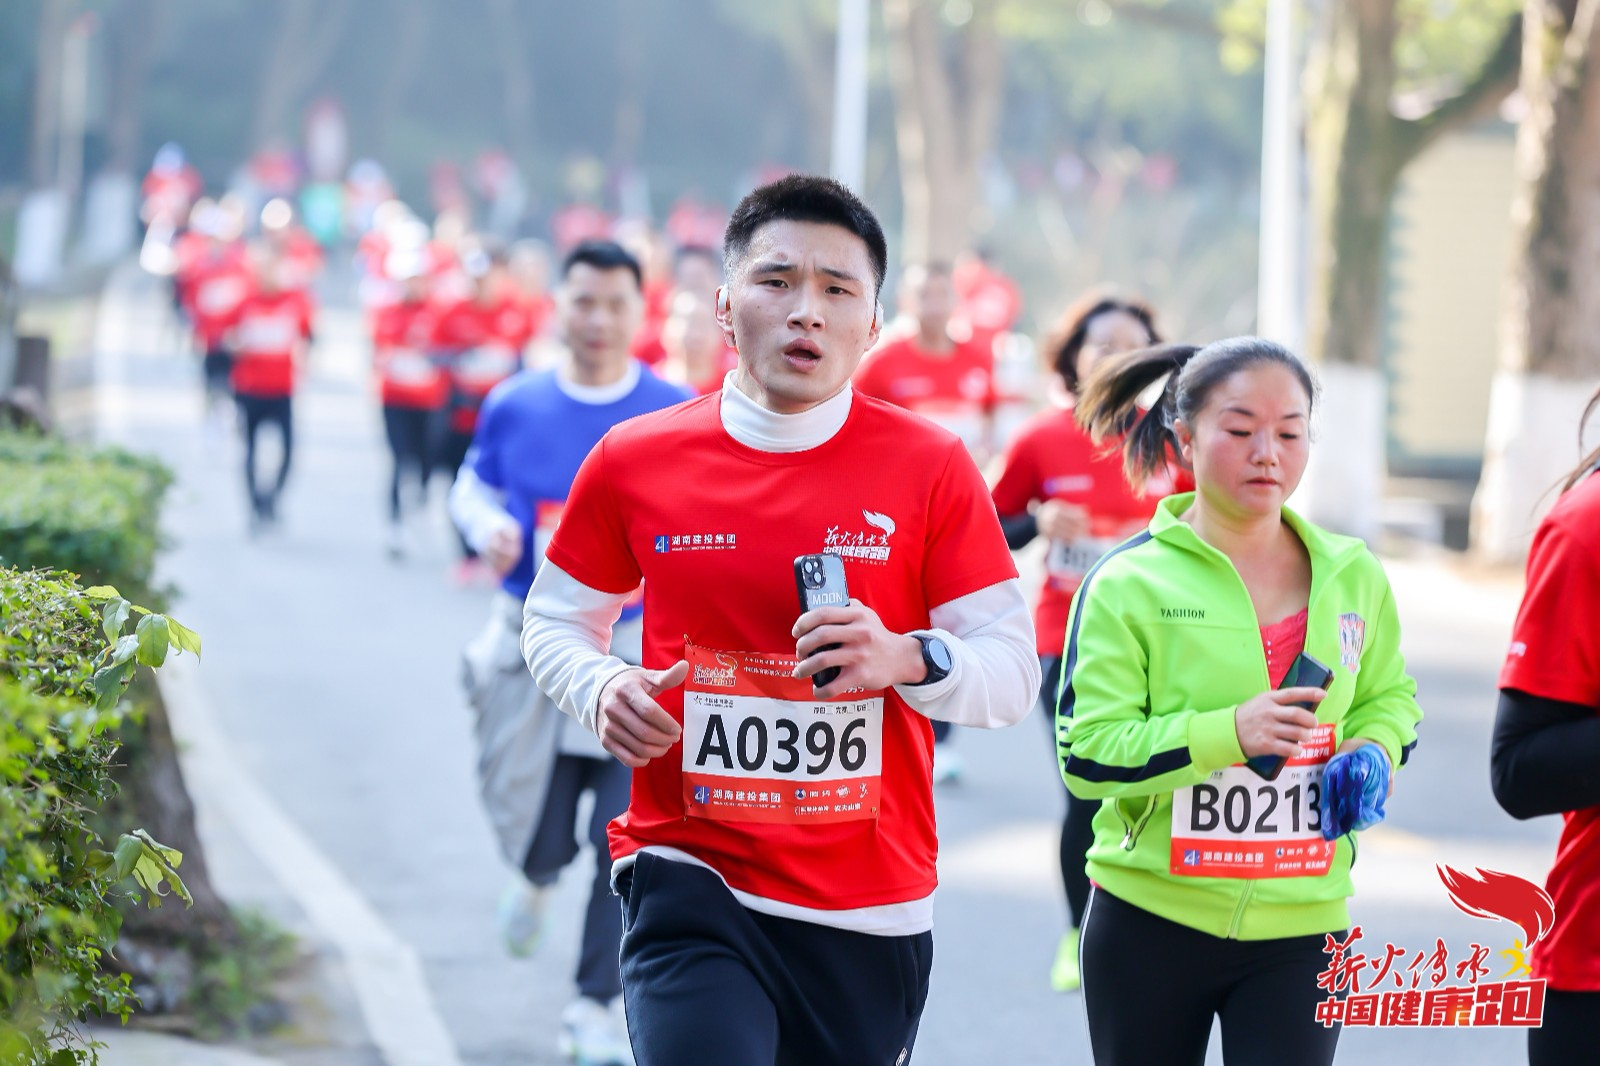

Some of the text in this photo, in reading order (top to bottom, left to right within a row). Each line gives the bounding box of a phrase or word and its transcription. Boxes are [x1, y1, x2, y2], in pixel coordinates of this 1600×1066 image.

[672, 534, 736, 546] 湖南建投集团
[812, 592, 843, 605] MOON
[695, 714, 867, 775] A0396
[712, 788, 781, 803] 湖南建投集团
[1190, 782, 1322, 834] B0213
